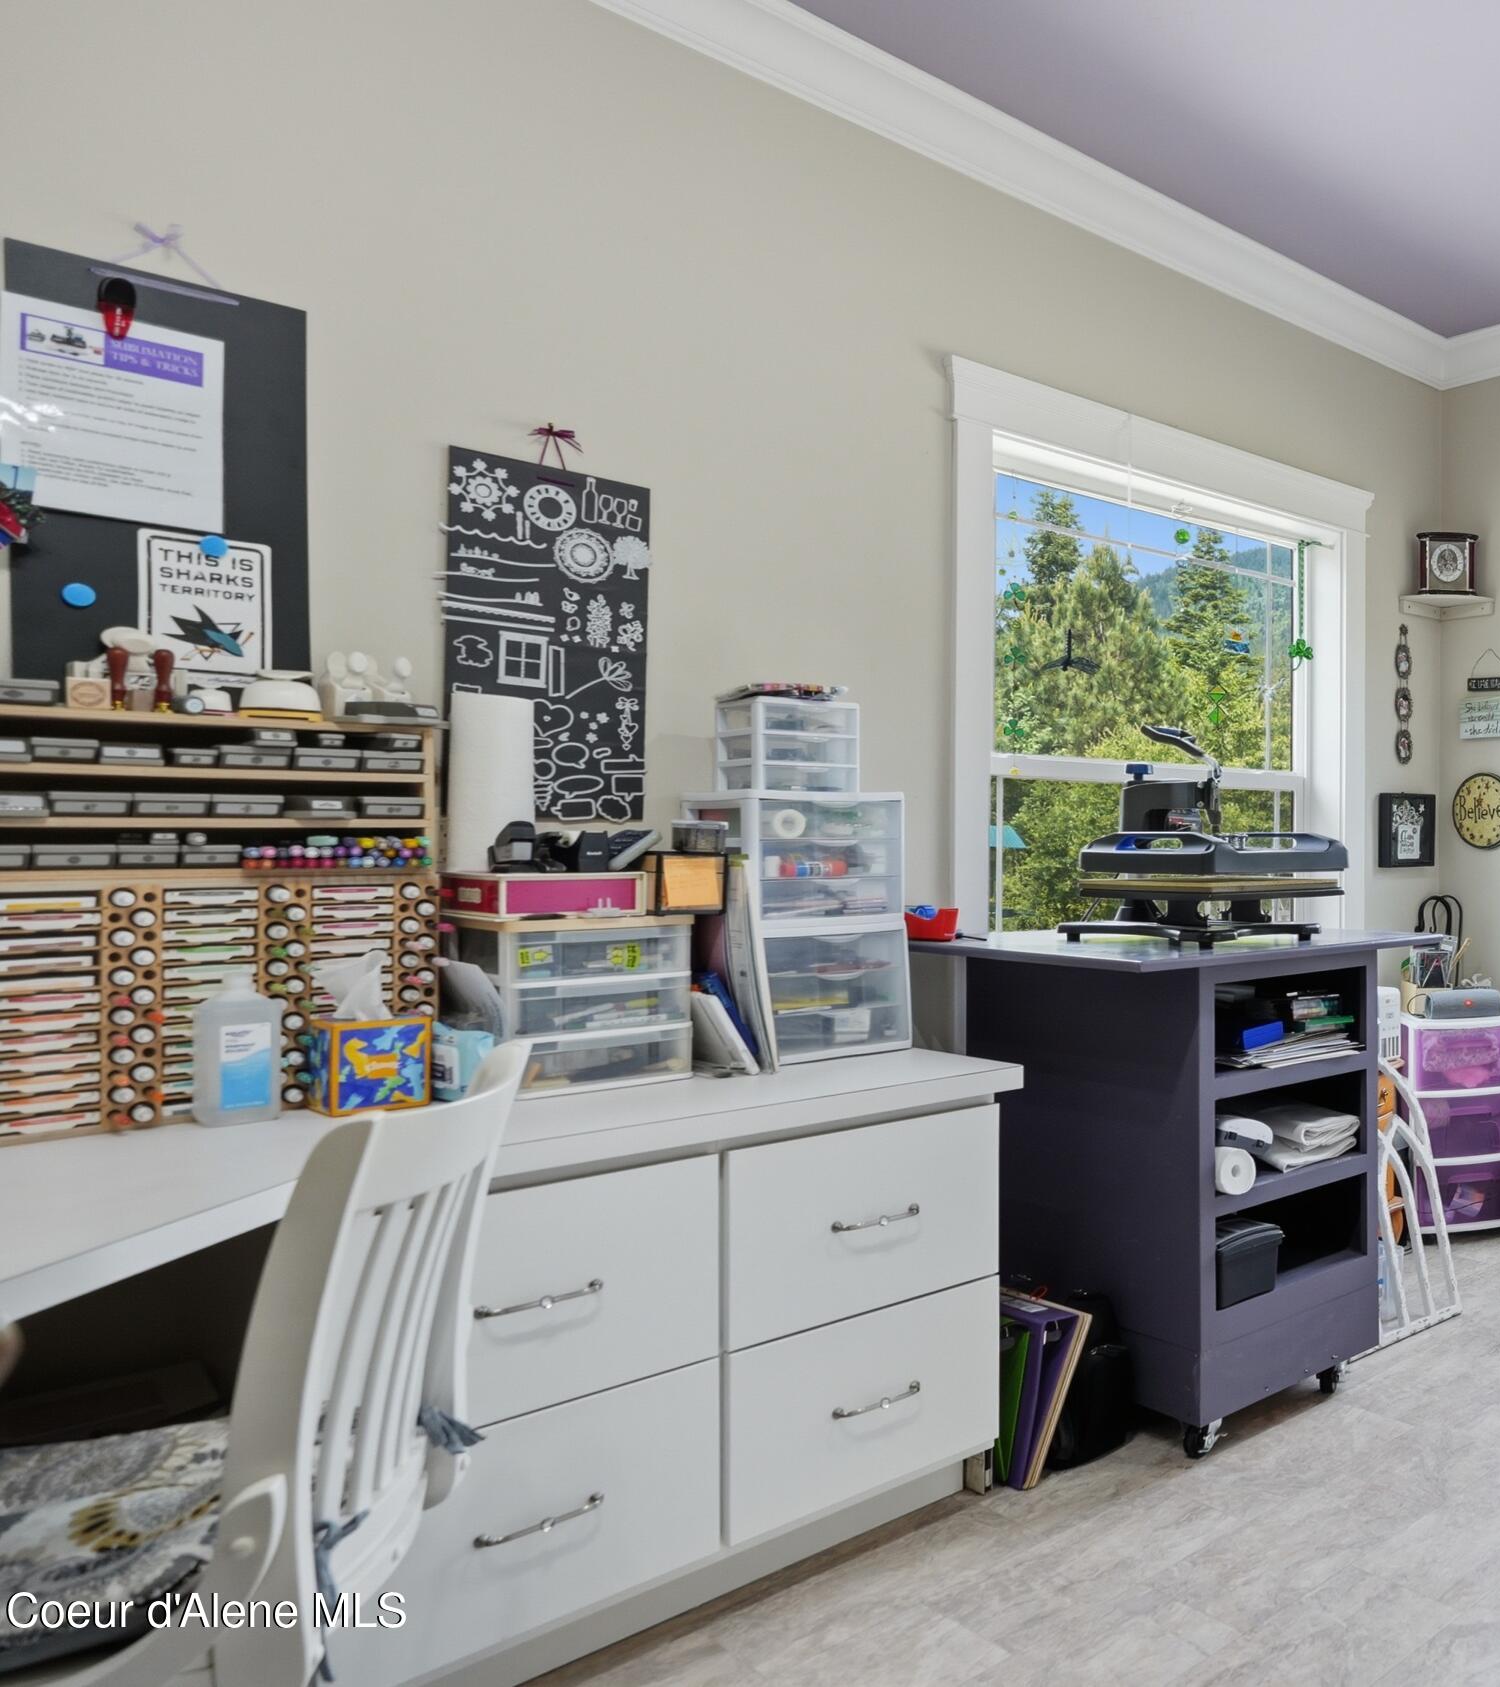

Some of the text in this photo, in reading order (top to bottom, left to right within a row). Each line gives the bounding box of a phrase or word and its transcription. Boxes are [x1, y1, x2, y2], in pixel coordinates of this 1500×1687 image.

[111, 351, 138, 366] TIPS
[155, 360, 199, 378] TRICKS
[158, 546, 254, 572] THIS IS
[159, 566, 254, 589] SHARKS
[158, 583, 256, 602] TERRITORY
